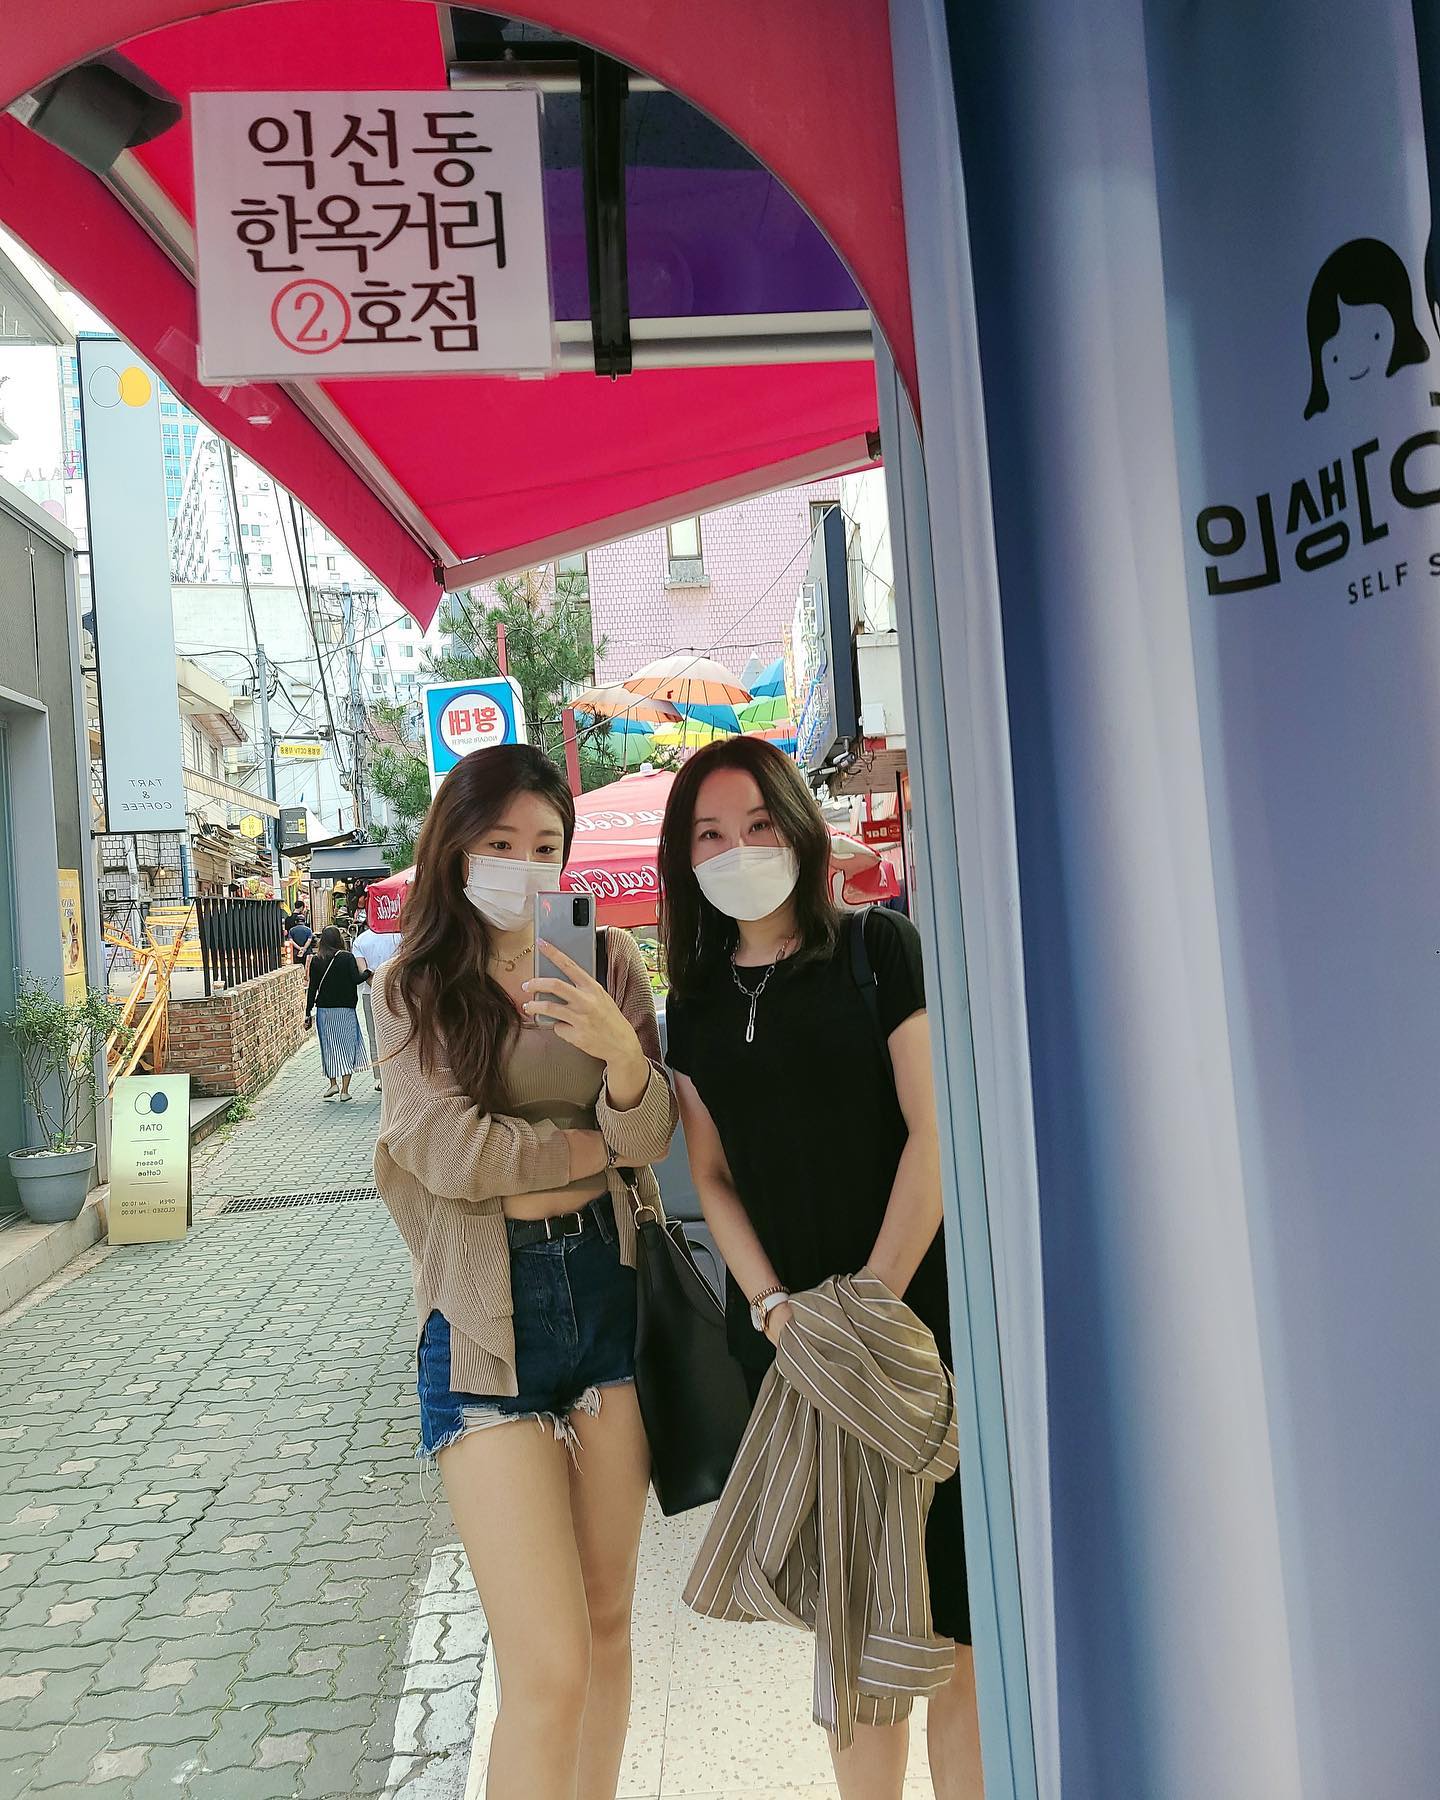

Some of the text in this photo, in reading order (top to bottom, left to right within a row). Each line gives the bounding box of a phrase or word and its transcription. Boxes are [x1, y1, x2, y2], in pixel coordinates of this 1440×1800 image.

[247, 109, 493, 190] 익선동
[231, 190, 507, 273] 한옥거리
[1348, 562, 1409, 605] SELF
